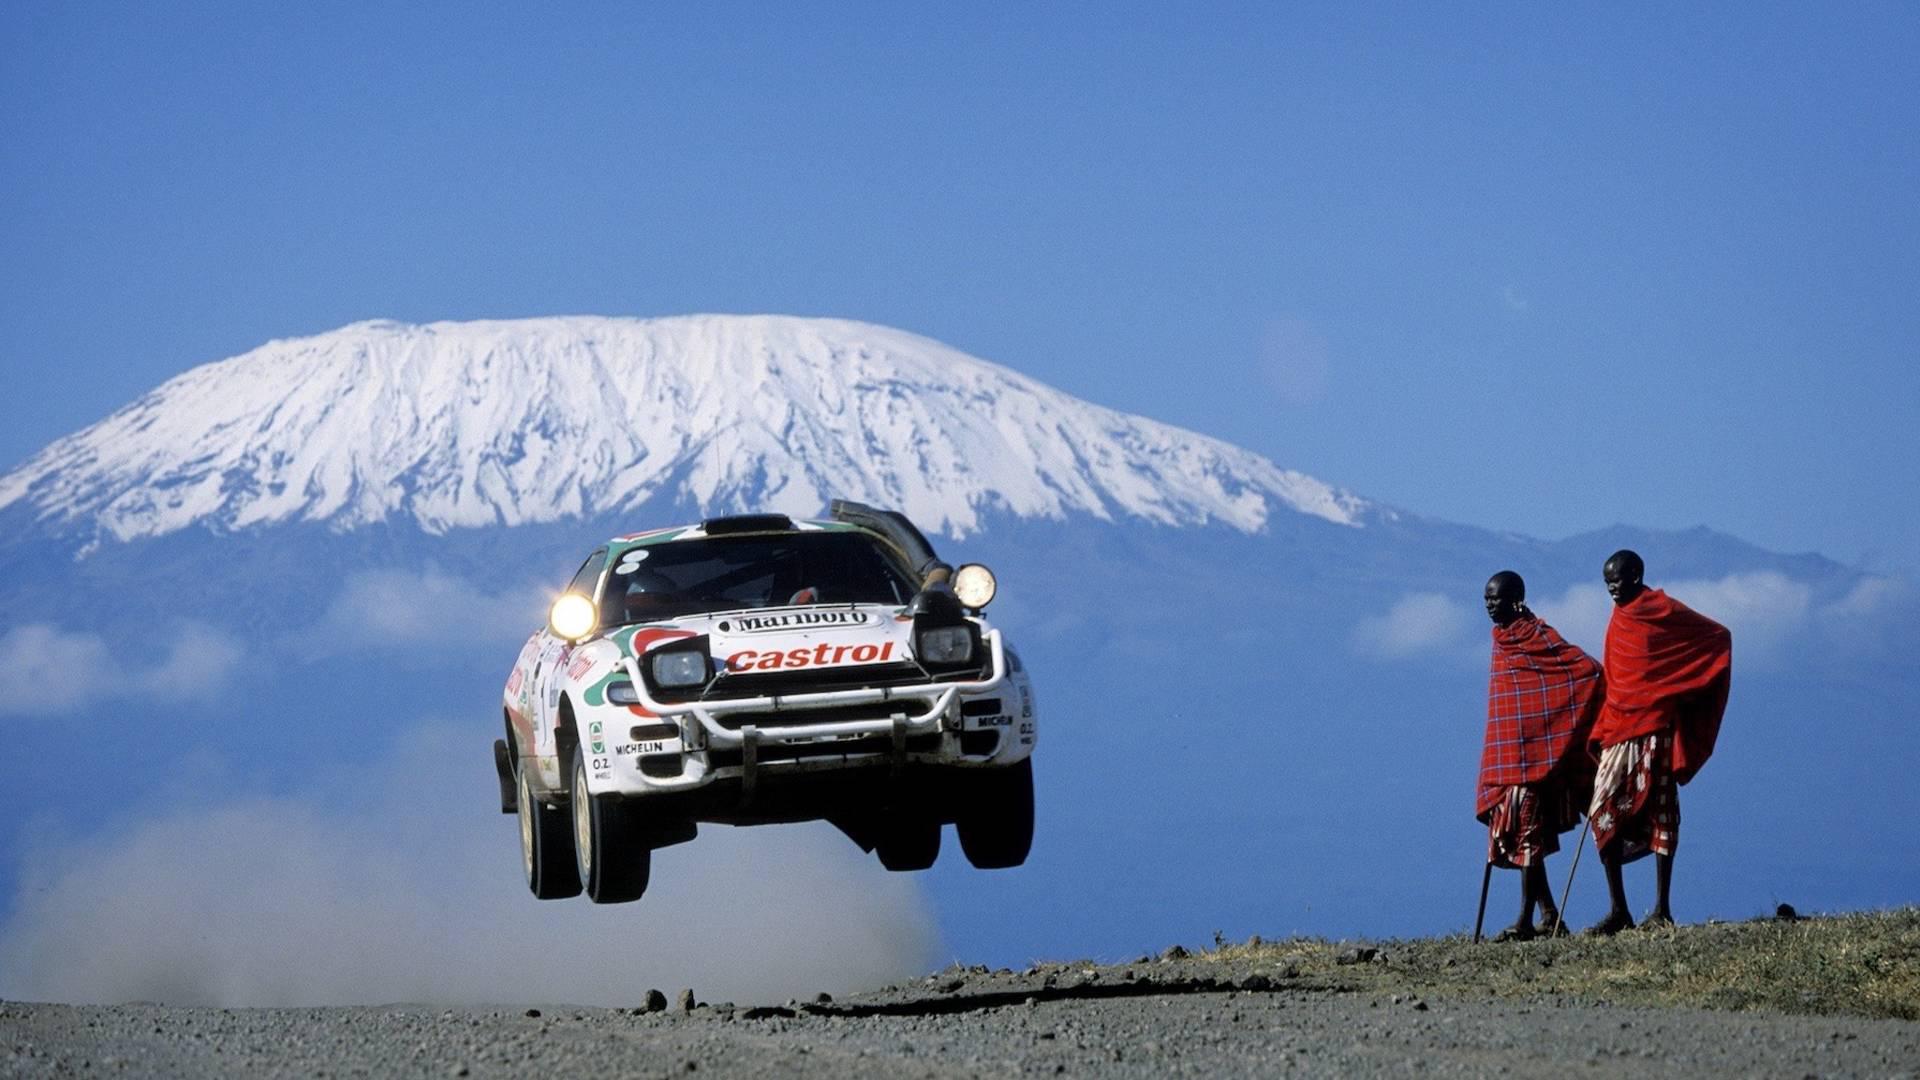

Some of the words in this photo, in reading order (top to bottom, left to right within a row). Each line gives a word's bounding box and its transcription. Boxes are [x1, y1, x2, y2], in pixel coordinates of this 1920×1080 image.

[740, 612, 867, 632] Marlboro
[726, 641, 894, 673] Castrol
[615, 742, 663, 755] MICHELIN
